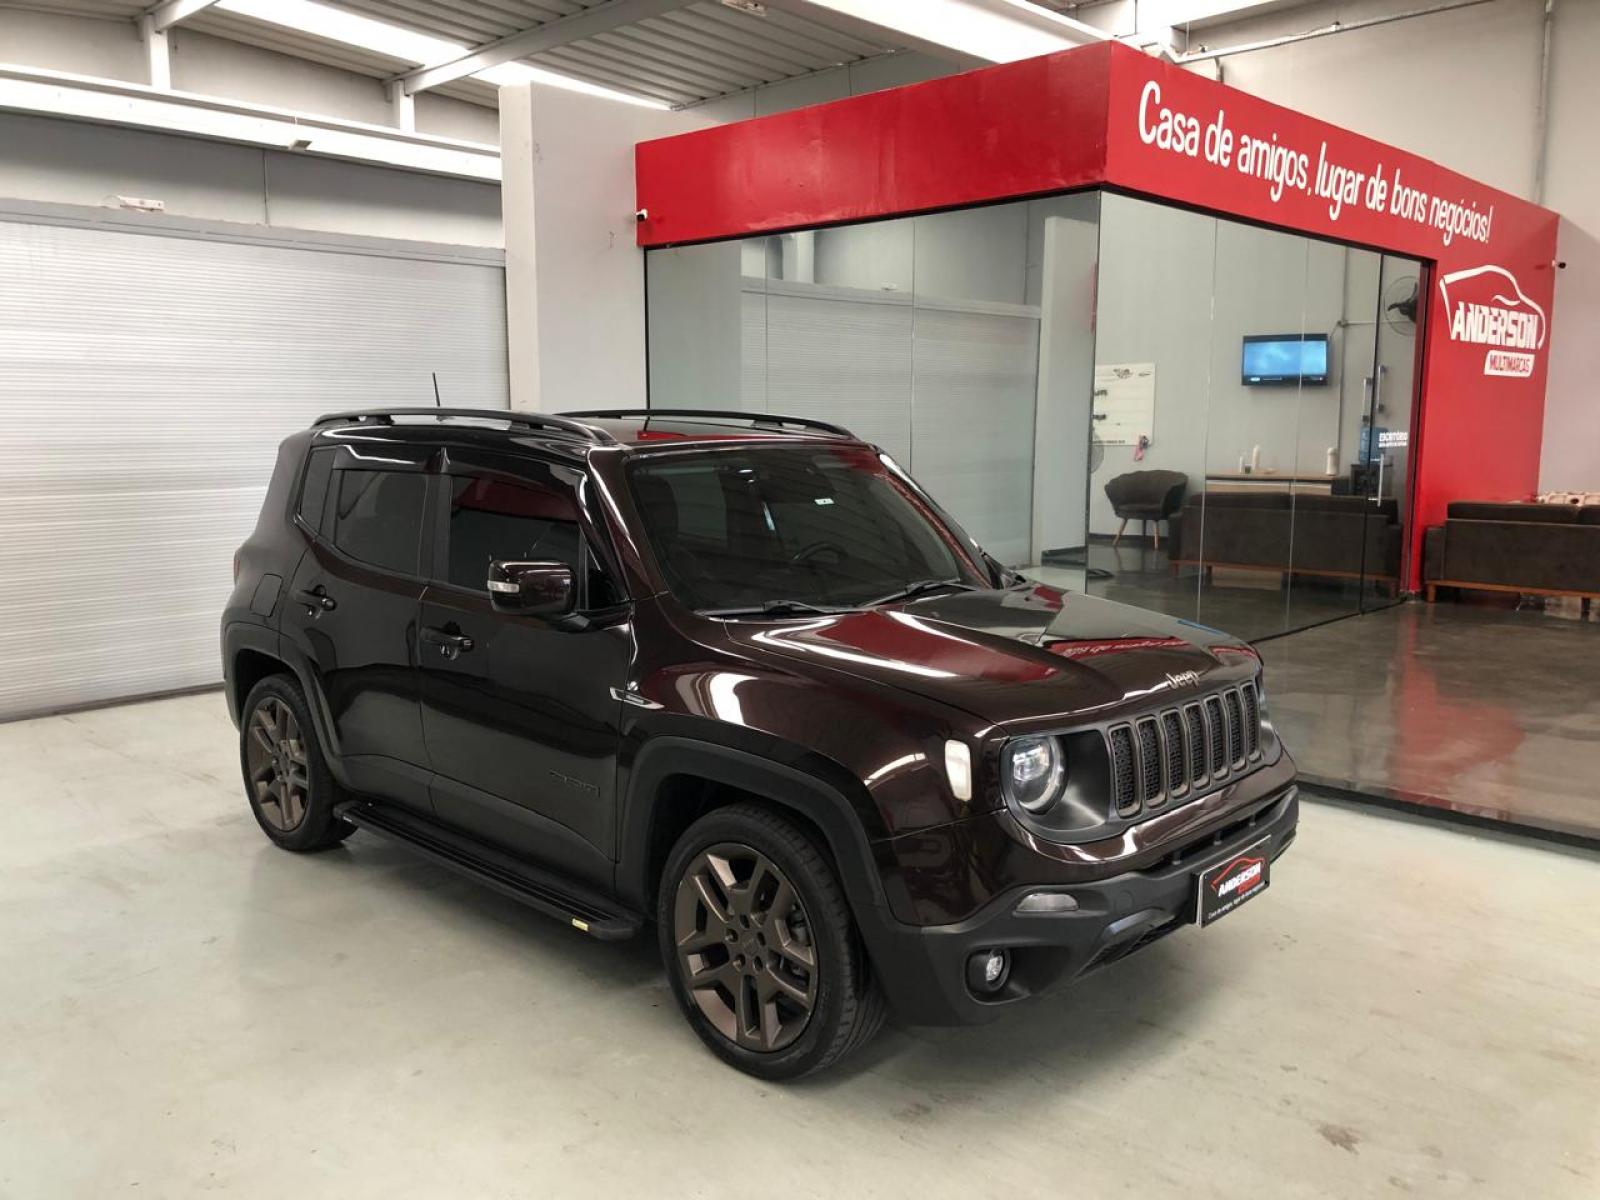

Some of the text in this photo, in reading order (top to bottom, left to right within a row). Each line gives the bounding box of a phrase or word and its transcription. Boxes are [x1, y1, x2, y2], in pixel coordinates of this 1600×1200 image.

[1138, 80, 1494, 247] Casa de amigos, lugar de bons negócios!
[1450, 301, 1539, 350] ANDERSON
[1489, 354, 1531, 374] MULTIMARCAS
[1165, 670, 1200, 690] Jeep
